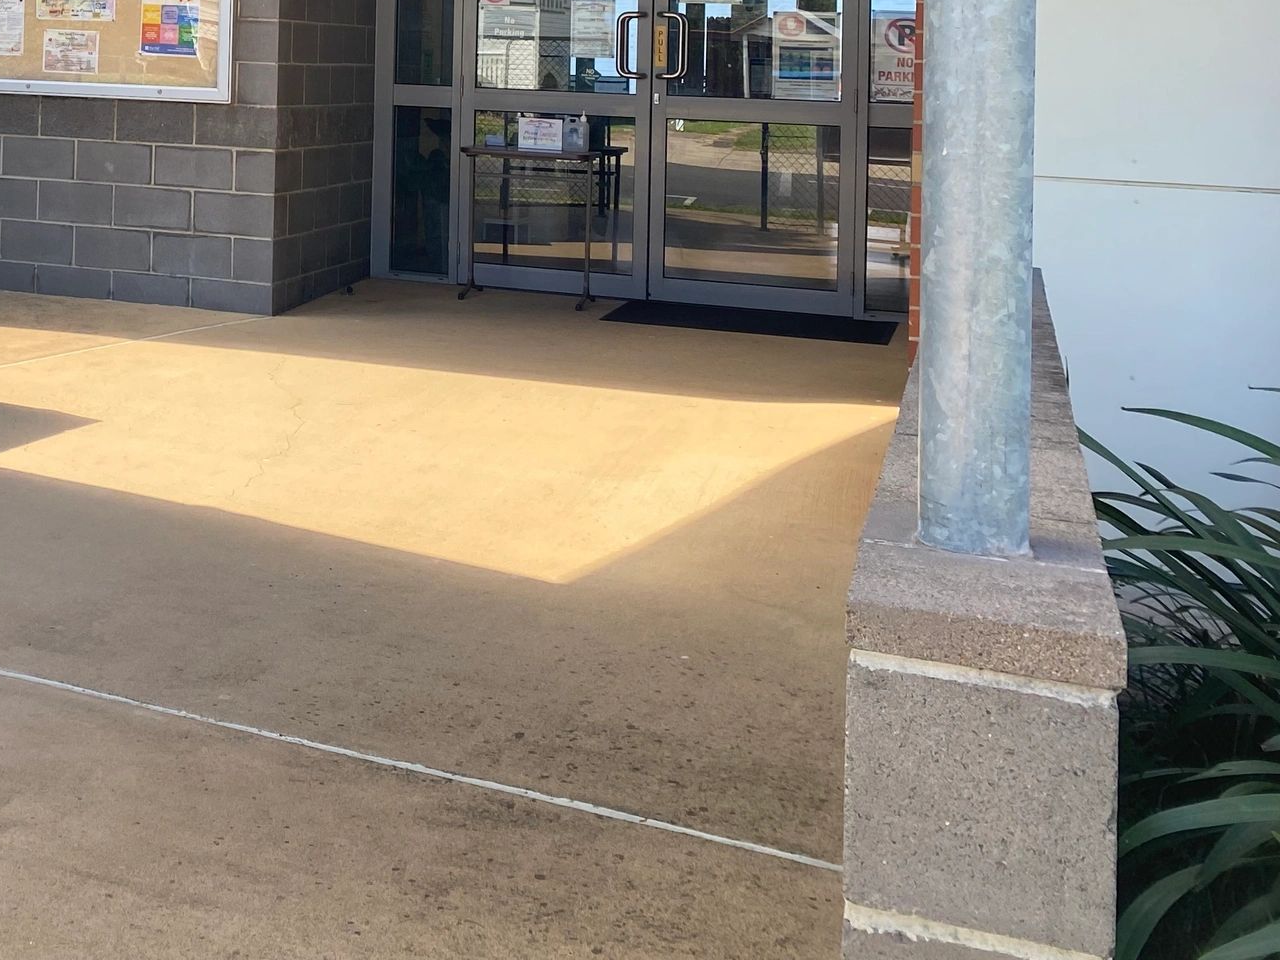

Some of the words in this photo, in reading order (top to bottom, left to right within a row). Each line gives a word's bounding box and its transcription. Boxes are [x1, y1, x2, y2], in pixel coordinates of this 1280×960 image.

[504, 16, 515, 24] No
[494, 27, 525, 38] Parking
[897, 58, 914, 68] NO
